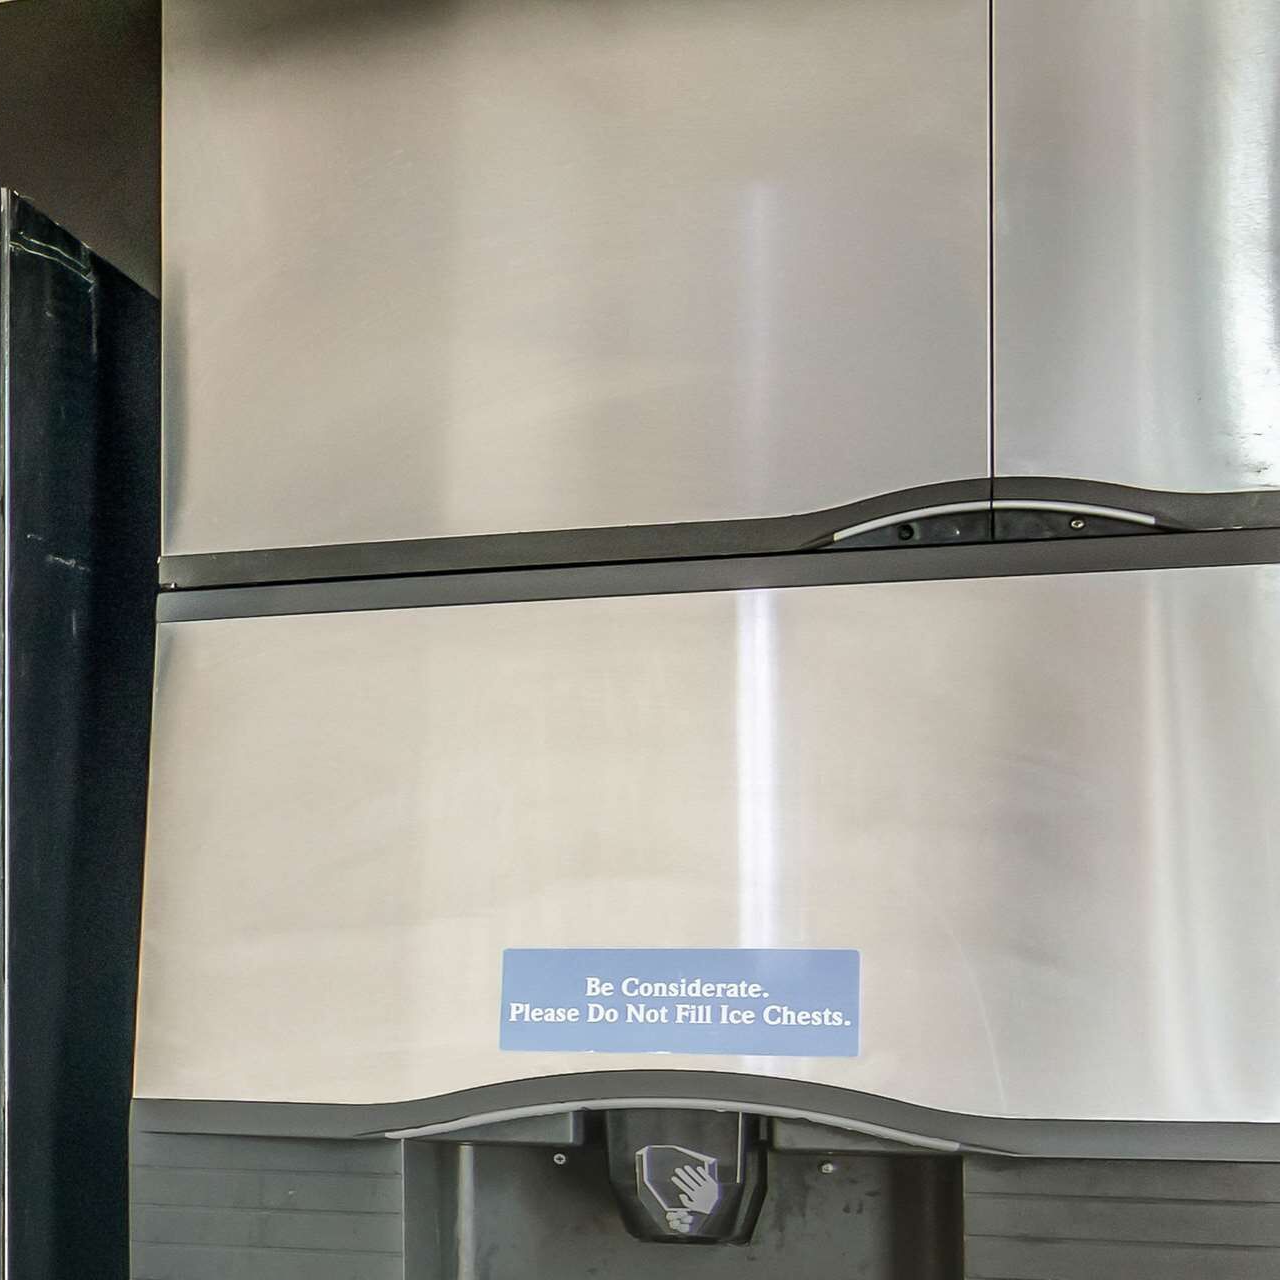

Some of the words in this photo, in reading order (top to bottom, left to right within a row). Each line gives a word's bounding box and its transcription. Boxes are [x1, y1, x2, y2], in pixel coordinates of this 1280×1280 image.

[585, 977, 614, 996] Be
[621, 977, 769, 998] Considerate.
[509, 1003, 580, 1023] Please
[587, 1003, 619, 1023] Do
[626, 1003, 669, 1024] Not
[675, 1004, 713, 1025] Fill
[720, 1005, 756, 1025] Ice
[763, 1005, 852, 1027] Chests.
